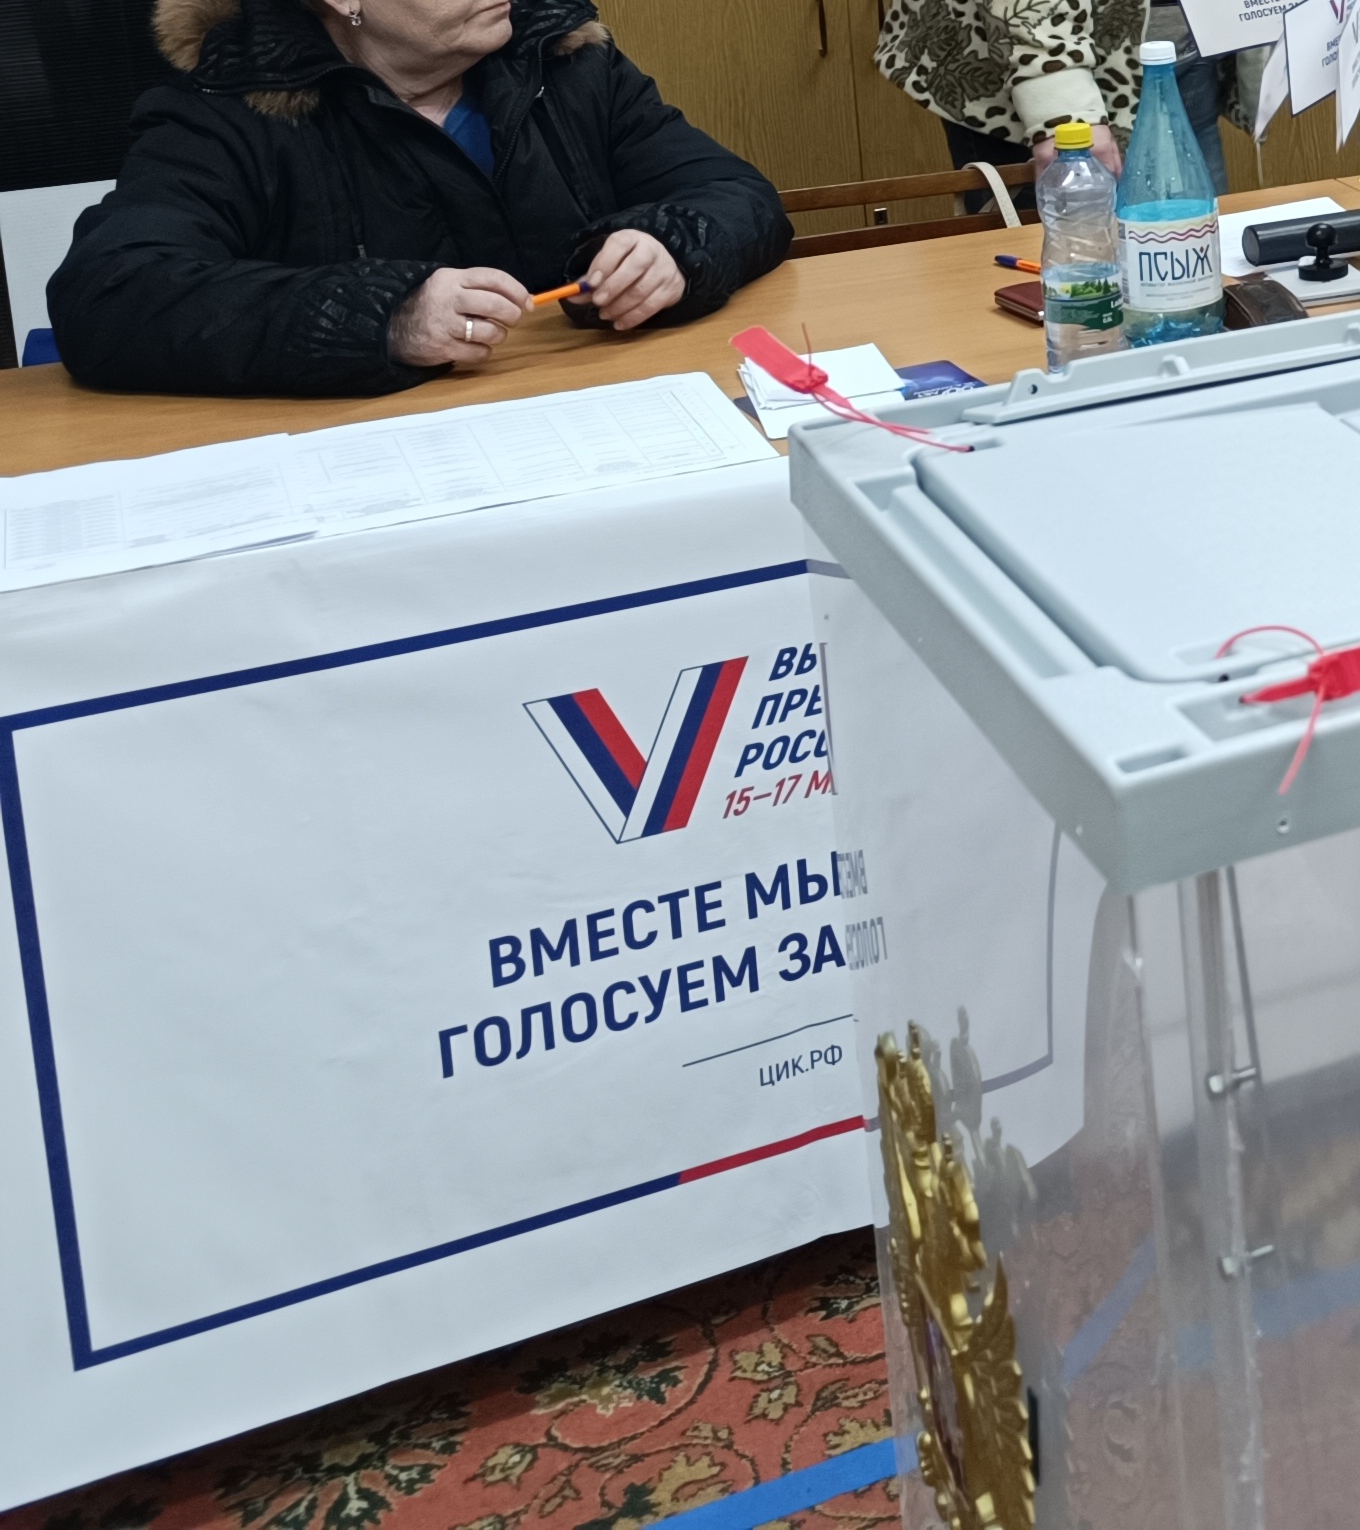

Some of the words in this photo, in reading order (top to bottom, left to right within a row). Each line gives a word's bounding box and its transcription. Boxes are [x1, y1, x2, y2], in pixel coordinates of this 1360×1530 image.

[1238, 4, 1287, 22] ГОЛОСУЕМ
[1138, 244, 1213, 282] ПСЫЖ
[488, 880, 726, 988] ВМЕСТЕ
[744, 851, 843, 920] МЫ
[438, 946, 760, 1078] ГОЛОСУЕМ
[777, 924, 847, 982] ЗА
[758, 1044, 843, 1087] ЦИК.РФ
